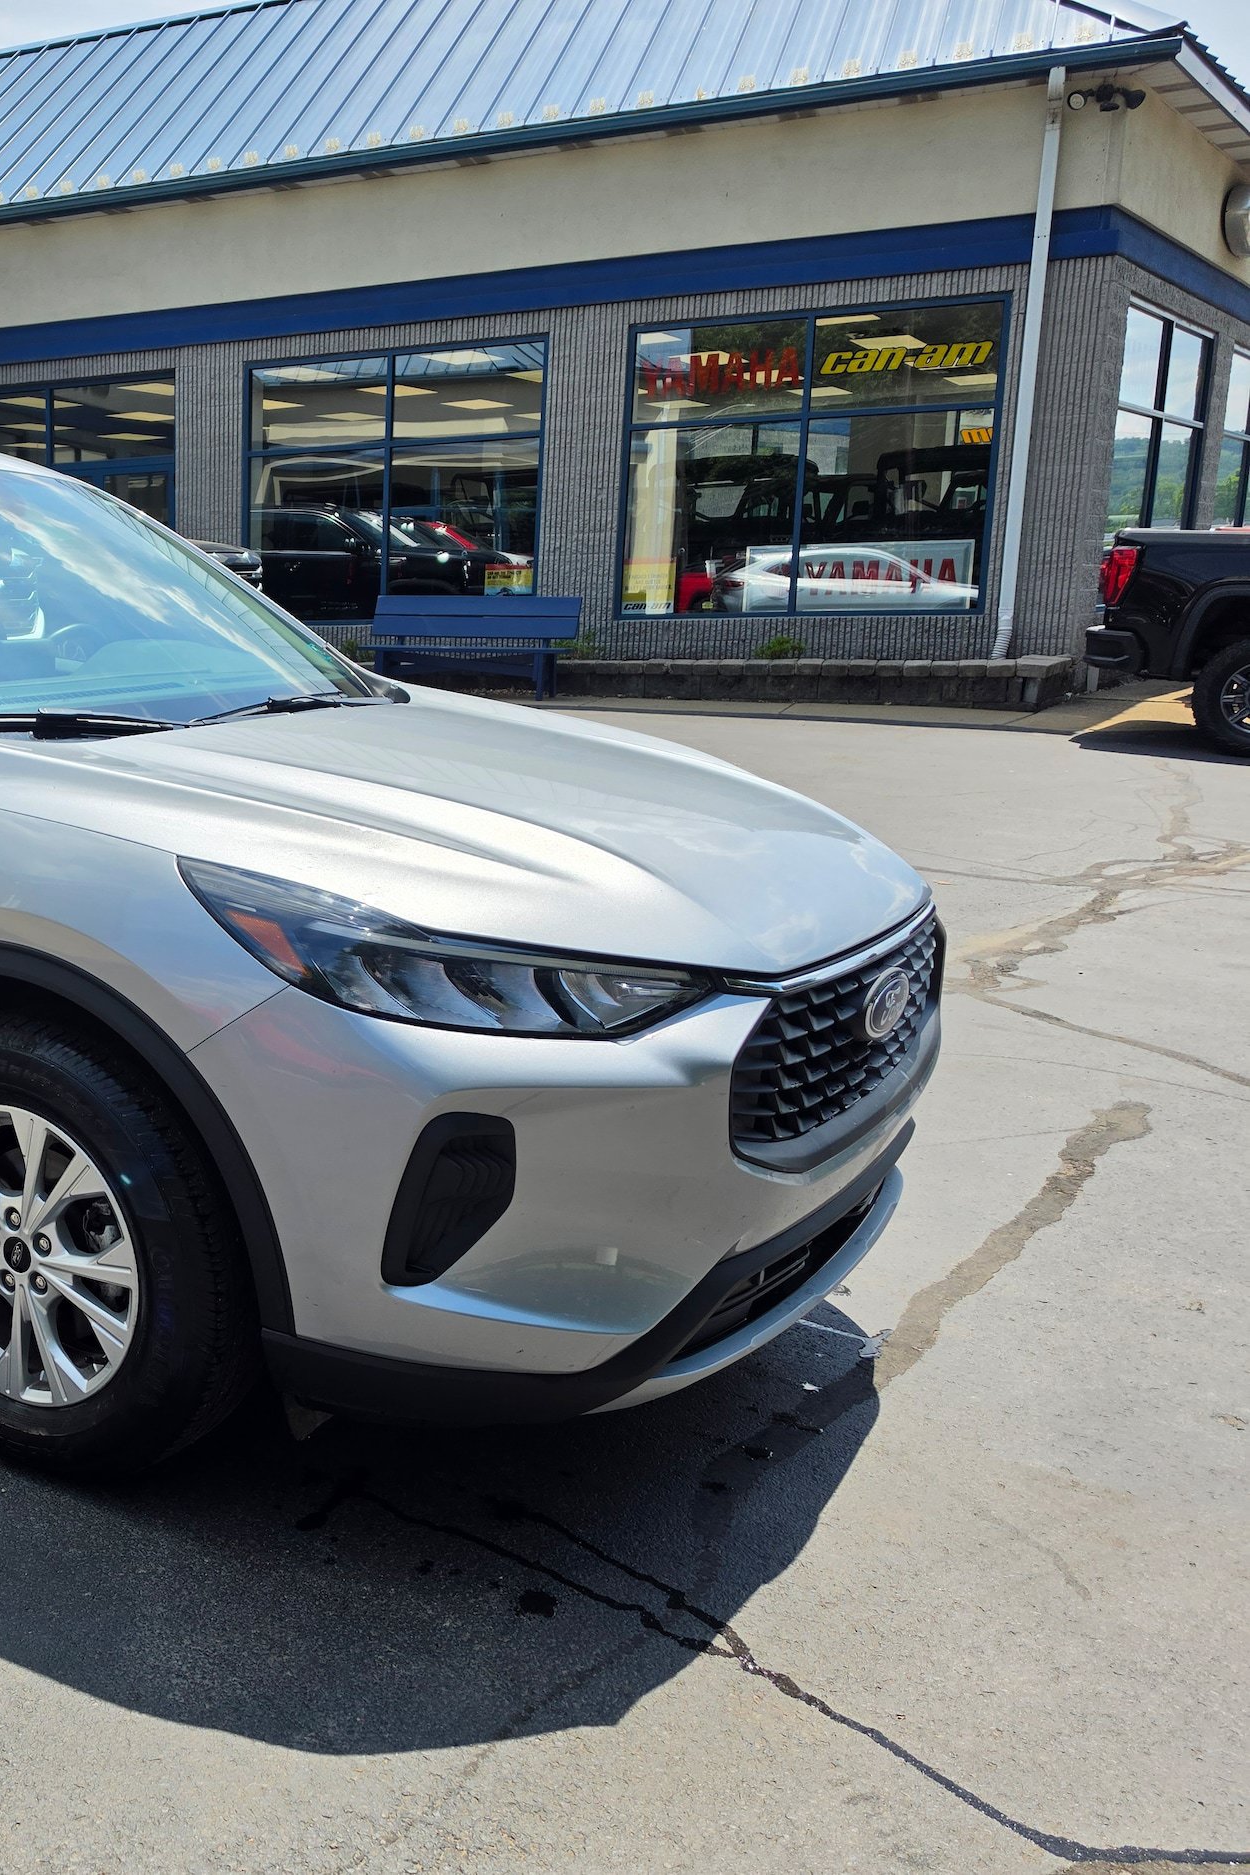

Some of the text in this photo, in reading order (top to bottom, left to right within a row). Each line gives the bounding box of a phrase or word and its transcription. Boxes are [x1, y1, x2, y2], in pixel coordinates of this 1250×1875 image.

[641, 347, 799, 398] YAMAHA
[819, 340, 994, 375] can-am
[805, 558, 957, 596] YAMAHA
